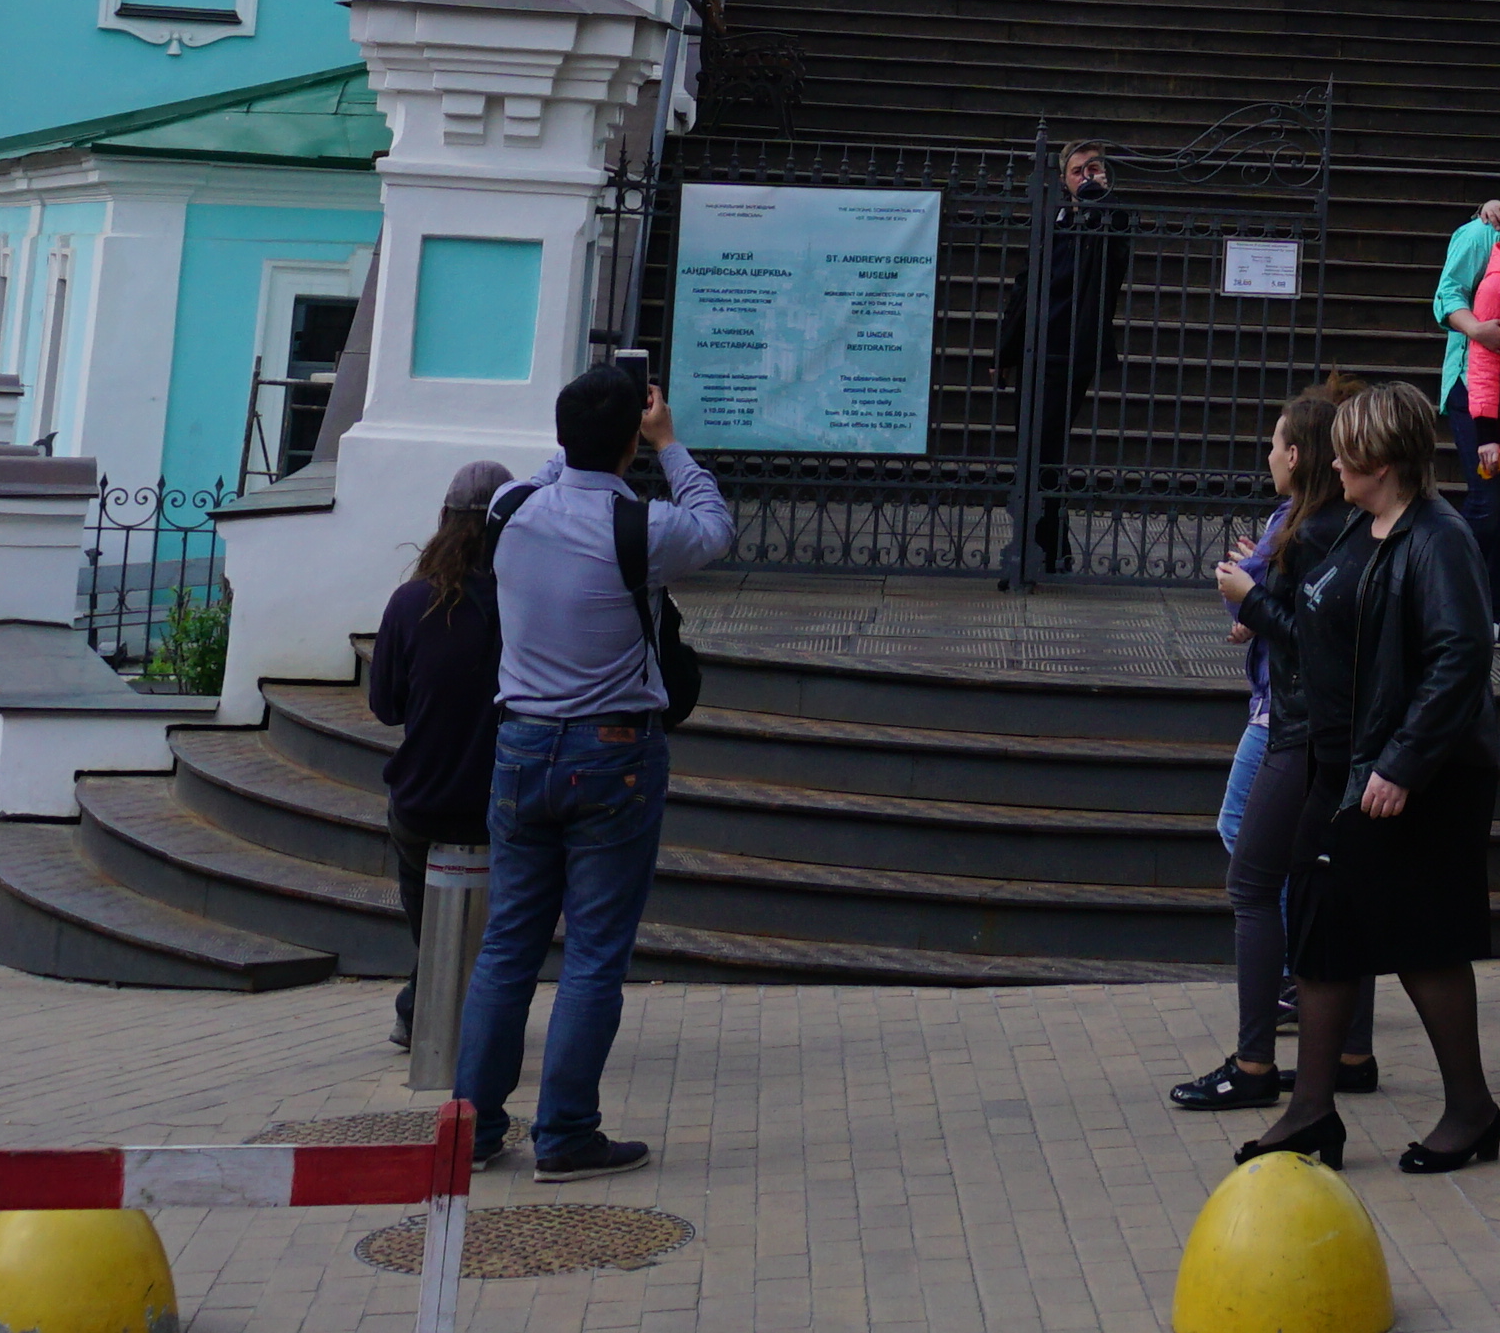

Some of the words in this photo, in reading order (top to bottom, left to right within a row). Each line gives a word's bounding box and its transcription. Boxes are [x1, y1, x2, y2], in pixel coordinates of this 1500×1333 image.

[721, 251, 754, 260] МУЗЕЙ
[826, 254, 840, 263] ST.
[842, 255, 891, 263] ANDREW'S
[893, 256, 932, 264] CHURCH
[750, 269, 792, 277] ЦЕРКВА»
[858, 271, 898, 279] MUSEUM
[847, 344, 902, 352] RESTORATION
